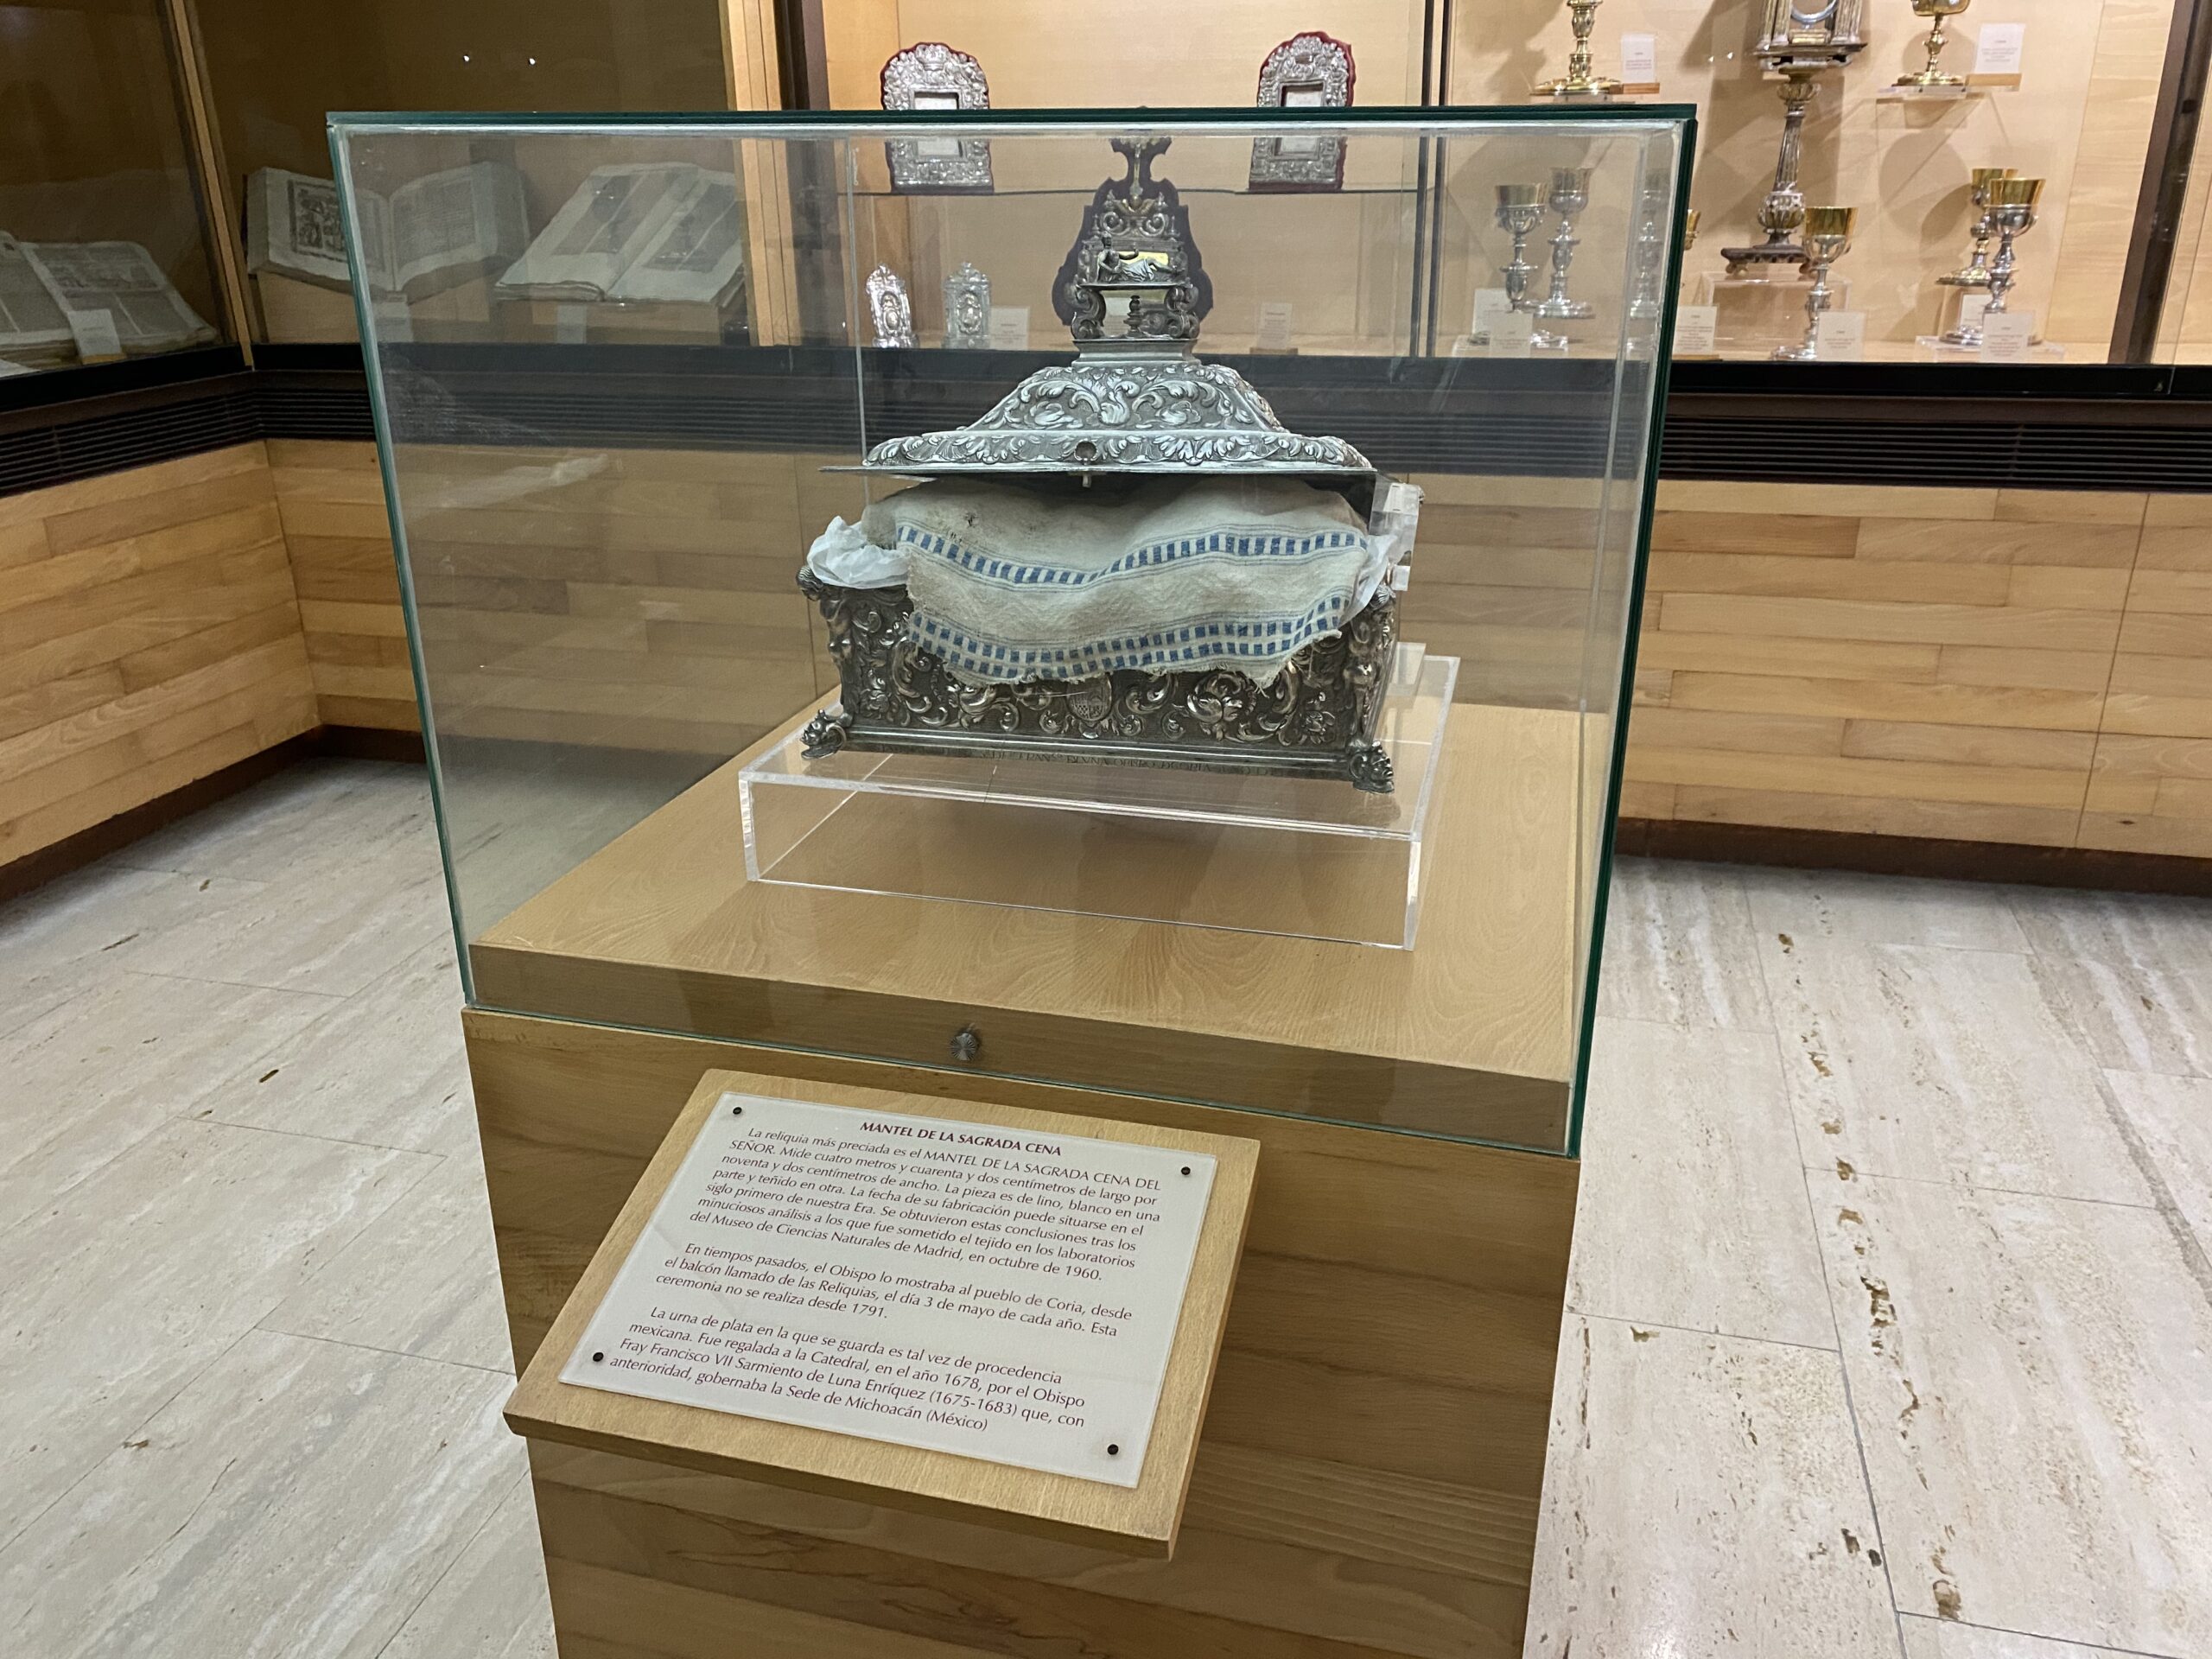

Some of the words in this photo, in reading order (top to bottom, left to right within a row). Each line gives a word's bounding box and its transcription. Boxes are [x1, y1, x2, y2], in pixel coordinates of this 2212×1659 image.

[728, 1139, 776, 1155] SEÑOR.
[779, 1146, 812, 1160] Mide
[813, 1153, 853, 1165] cuatro
[855, 1158, 898, 1171] metros
[898, 1164, 909, 1175] y
[909, 1166, 963, 1179] cuarenta
[964, 1173, 976, 1184] y
[976, 1171, 1001, 1185] dos
[1001, 1178, 1077, 1195] centímetros
[1078, 1185, 1096, 1198] de
[1098, 1186, 1131, 1205] largo
[1133, 1195, 1158, 1207] por
[747, 1128, 763, 1138] La
[764, 1130, 810, 1146] reliquia
[811, 1137, 837, 1147] más
[836, 1141, 891, 1155] preciada
[893, 1148, 907, 1157] es
[909, 1147, 923, 1159] el
[922, 1150, 978, 1166] MANTEL
[982, 1157, 1002, 1169] DE
[1003, 1160, 1020, 1173] LA
[1023, 1163, 1090, 1181] SAGRADA
[1093, 1172, 1131, 1187] CENA
[1135, 1178, 1161, 1191] DEL
[859, 1122, 913, 1137] MANTEL
[916, 1128, 938, 1141] DE
[938, 1131, 955, 1143] LA
[957, 1134, 1021, 1151] SAGRADA
[1025, 1142, 1061, 1157] CENA
[705, 1182, 734, 1197] siglo
[733, 1186, 785, 1202] primero
[786, 1192, 804, 1205] de
[804, 1198, 851, 1211] nuestra
[853, 1201, 876, 1215] Era.
[880, 1205, 897, 1217] Se
[899, 1208, 968, 1228] obtuvieron
[970, 1220, 1002, 1232] estas
[1004, 1225, 1089, 1244] conclusiones
[1090, 1236, 1115, 1249] tras
[1117, 1237, 1136, 1252] los
[711, 1169, 746, 1181] parte
[746, 1173, 757, 1185] y
[758, 1174, 798, 1188] teñido
[799, 1181, 817, 1191] en
[818, 1183, 846, 1195] otra.
[849, 1185, 865, 1198] La
[868, 1187, 902, 1202] fecha
[904, 1192, 922, 1205] de
[922, 1198, 939, 1207] su
[941, 1197, 1011, 1217] fabricación
[1012, 1210, 1056, 1224] puede
[1057, 1214, 1108, 1231] situarse
[1110, 1224, 1128, 1234] en
[1130, 1224, 1145, 1236] el
[721, 1155, 770, 1169] noventa
[770, 1161, 781, 1173] y
[782, 1160, 805, 1173] dos
[806, 1166, 878, 1184] centímetros
[880, 1174, 897, 1186] de
[898, 1179, 940, 1192] ancho.
[944, 1182, 960, 1195] La
[961, 1185, 996, 1199] pieza
[999, 1192, 1014, 1202] es
[1016, 1192, 1033, 1205] de
[1036, 1193, 1065, 1211] lino,
[1069, 1198, 1112, 1216] blanco
[1115, 1208, 1132, 1218] en
[1135, 1211, 1160, 1222] una
[690, 1210, 712, 1224] del
[711, 1213, 754, 1230] Museo
[756, 1219, 773, 1232] de
[776, 1223, 829, 1240] Ciencias
[830, 1230, 892, 1249] Naturales
[893, 1239, 911, 1252] de
[912, 1243, 964, 1262] Madrid,
[968, 1253, 986, 1263] en
[988, 1256, 1039, 1271] octubre
[1042, 1261, 1061, 1274] de
[1065, 1265, 1103, 1281] 1960.
[697, 1197, 766, 1216] minuciosos
[766, 1208, 812, 1222] análisis
[813, 1215, 823, 1224] a
[824, 1212, 844, 1226] los
[845, 1219, 871, 1231] que
[873, 1220, 895, 1234] fue
[895, 1226, 957, 1243] sometido
[959, 1232, 973, 1245] el
[974, 1236, 1013, 1251] tejido
[1014, 1243, 1033, 1254] en
[1034, 1243, 1055, 1256] los
[1057, 1245, 1135, 1268] laboratorios
[656, 1274, 722, 1293] ceremonia
[724, 1285, 743, 1295] no
[745, 1288, 760, 1299] se
[762, 1290, 805, 1306] realiza
[807, 1295, 848, 1313] desde
[852, 1302, 887, 1319] 1791.
[664, 1256, 679, 1268] el
[678, 1257, 722, 1275] balcón
[723, 1264, 776, 1283] llamado
[777, 1273, 796, 1287] de
[797, 1275, 817, 1290] las
[817, 1280, 880, 1302] Reliquias,
[883, 1289, 899, 1302] el
[899, 1292, 921, 1306] día
[923, 1296, 934, 1307] 3
[936, 1297, 955, 1311] de
[957, 1303, 995, 1319] mayo
[998, 1306, 1017, 1320] de
[1020, 1313, 1052, 1326] cada
[1055, 1318, 1085, 1332] año.
[1090, 1321, 1117, 1337] Esta
[684, 1243, 702, 1255] En
[703, 1246, 754, 1264] tiempos
[753, 1255, 810, 1274] pasados,
[813, 1262, 829, 1274] el
[829, 1264, 877, 1283] Obispo
[879, 1270, 893, 1284] lo
[895, 1276, 956, 1294] mostraba
[957, 1283, 973, 1296] al
[972, 1288, 1021, 1304] pueblo
[1024, 1293, 1043, 1306] de
[1046, 1297, 1086, 1317] Coria,
[1090, 1303, 1133, 1320] desde
[628, 1324, 693, 1343] mexicana.
[697, 1332, 722, 1347] Fue
[723, 1338, 780, 1357] regalada
[782, 1349, 792, 1358] a
[794, 1346, 807, 1361] la
[810, 1351, 870, 1375] Catedral,
[874, 1364, 893, 1376] en
[895, 1364, 912, 1378] el
[912, 1369, 939, 1383] año
[944, 1372, 982, 1394] 1678,
[986, 1382, 1014, 1397] por
[1015, 1384, 1031, 1399] el
[1033, 1388, 1085, 1410] Obispo
[650, 1306, 666, 1319] La
[668, 1312, 699, 1325] urna
[701, 1314, 720, 1328] de
[718, 1318, 754, 1333] plata
[756, 1326, 774, 1338] en
[776, 1325, 789, 1339] la
[791, 1332, 819, 1345] que
[820, 1337, 837, 1347] se
[836, 1339, 885, 1355] guarda
[888, 1347, 905, 1358] es
[906, 1348, 925, 1362] tal
[927, 1354, 952, 1366] vez
[953, 1355, 973, 1370] de
[974, 1362, 1062, 1384] procedencia
[609, 1357, 693, 1382] anterioridad,
[694, 1370, 768, 1393] gobernaba
[770, 1381, 784, 1395] la
[785, 1384, 821, 1402] Sede
[823, 1390, 842, 1406] de
[843, 1395, 922, 1420] Michoacán
[925, 1408, 988, 1432] (México)
[620, 1338, 649, 1357] Fray
[649, 1342, 710, 1363] Francisco
[715, 1352, 734, 1368] VII
[734, 1357, 804, 1380] Sarmiento
[805, 1368, 825, 1383] de
[827, 1372, 861, 1389] Luna
[864, 1378, 927, 1401] Enríquez
[929, 1389, 1018, 1417] (1675-1683)
[1020, 1408, 1052, 1425] que,
[1057, 1414, 1084, 1427] con
